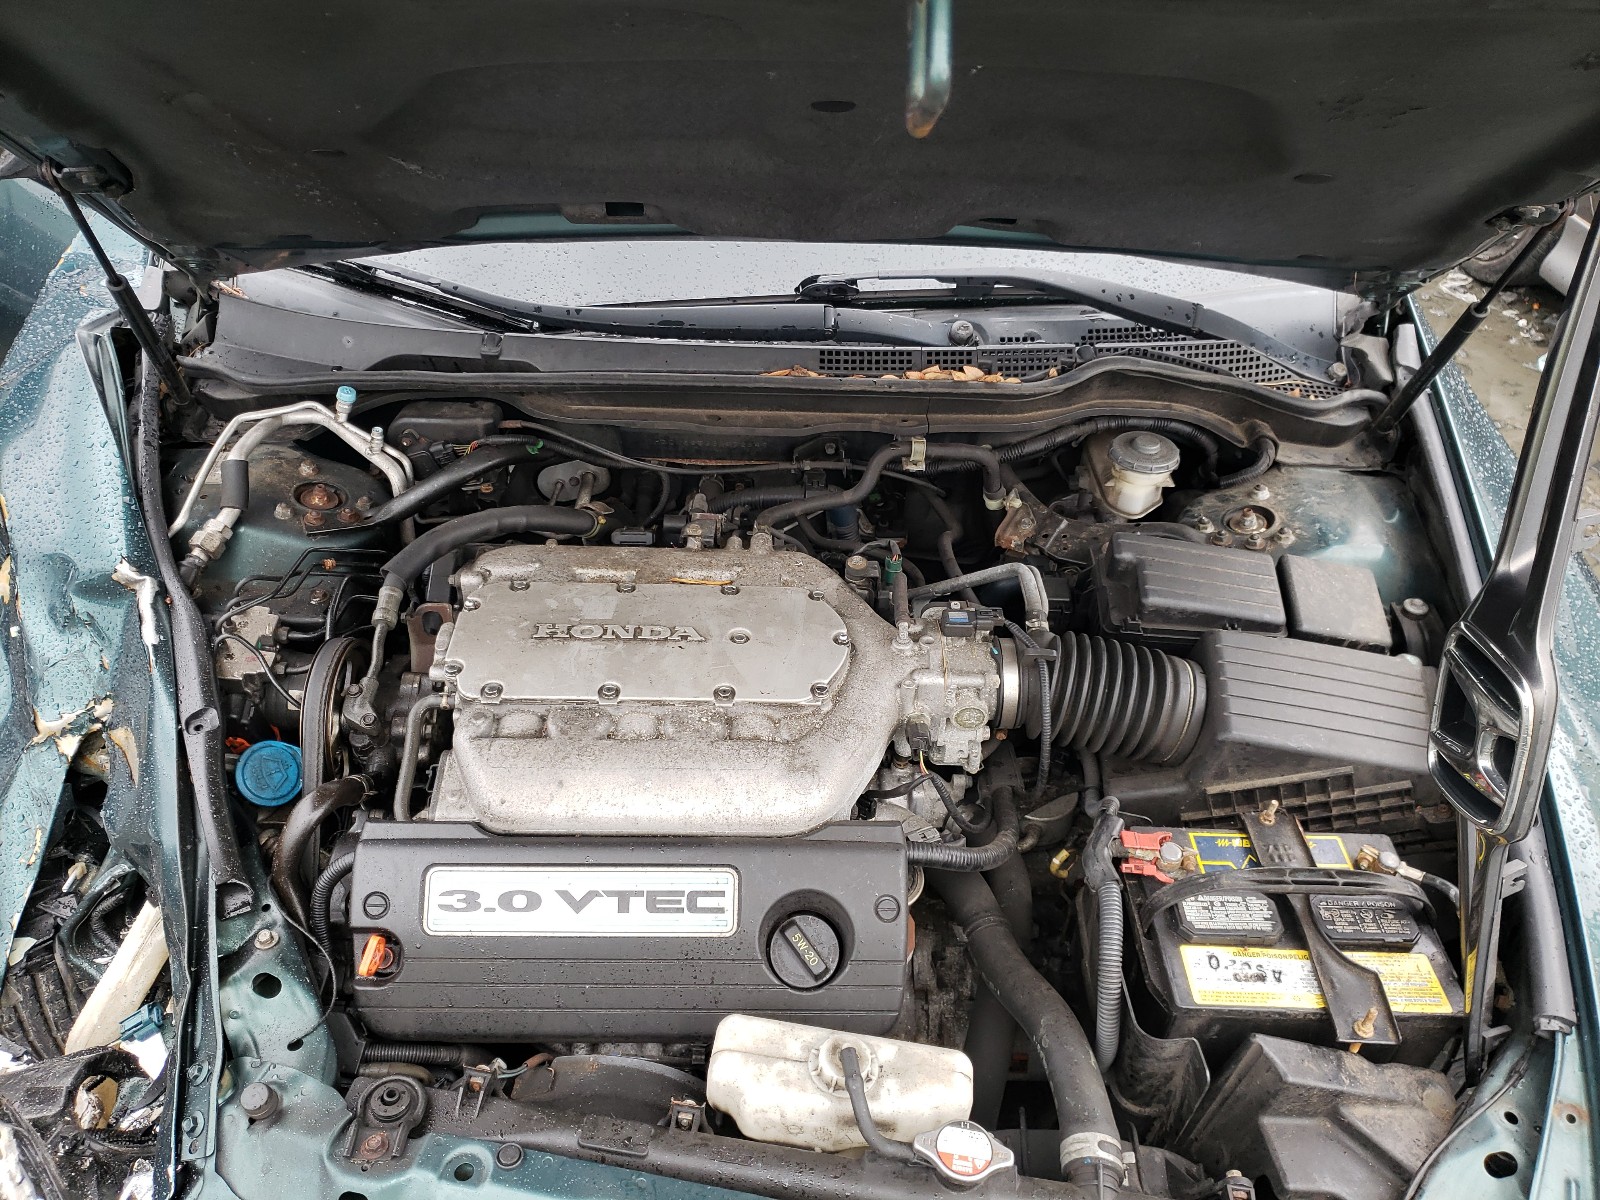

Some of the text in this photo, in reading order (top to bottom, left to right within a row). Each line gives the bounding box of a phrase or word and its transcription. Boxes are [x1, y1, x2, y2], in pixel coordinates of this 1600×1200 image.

[532, 622, 707, 643] HONDA
[437, 889, 726, 914] 3.0 VTEC
[792, 932, 819, 966] 5W-20
